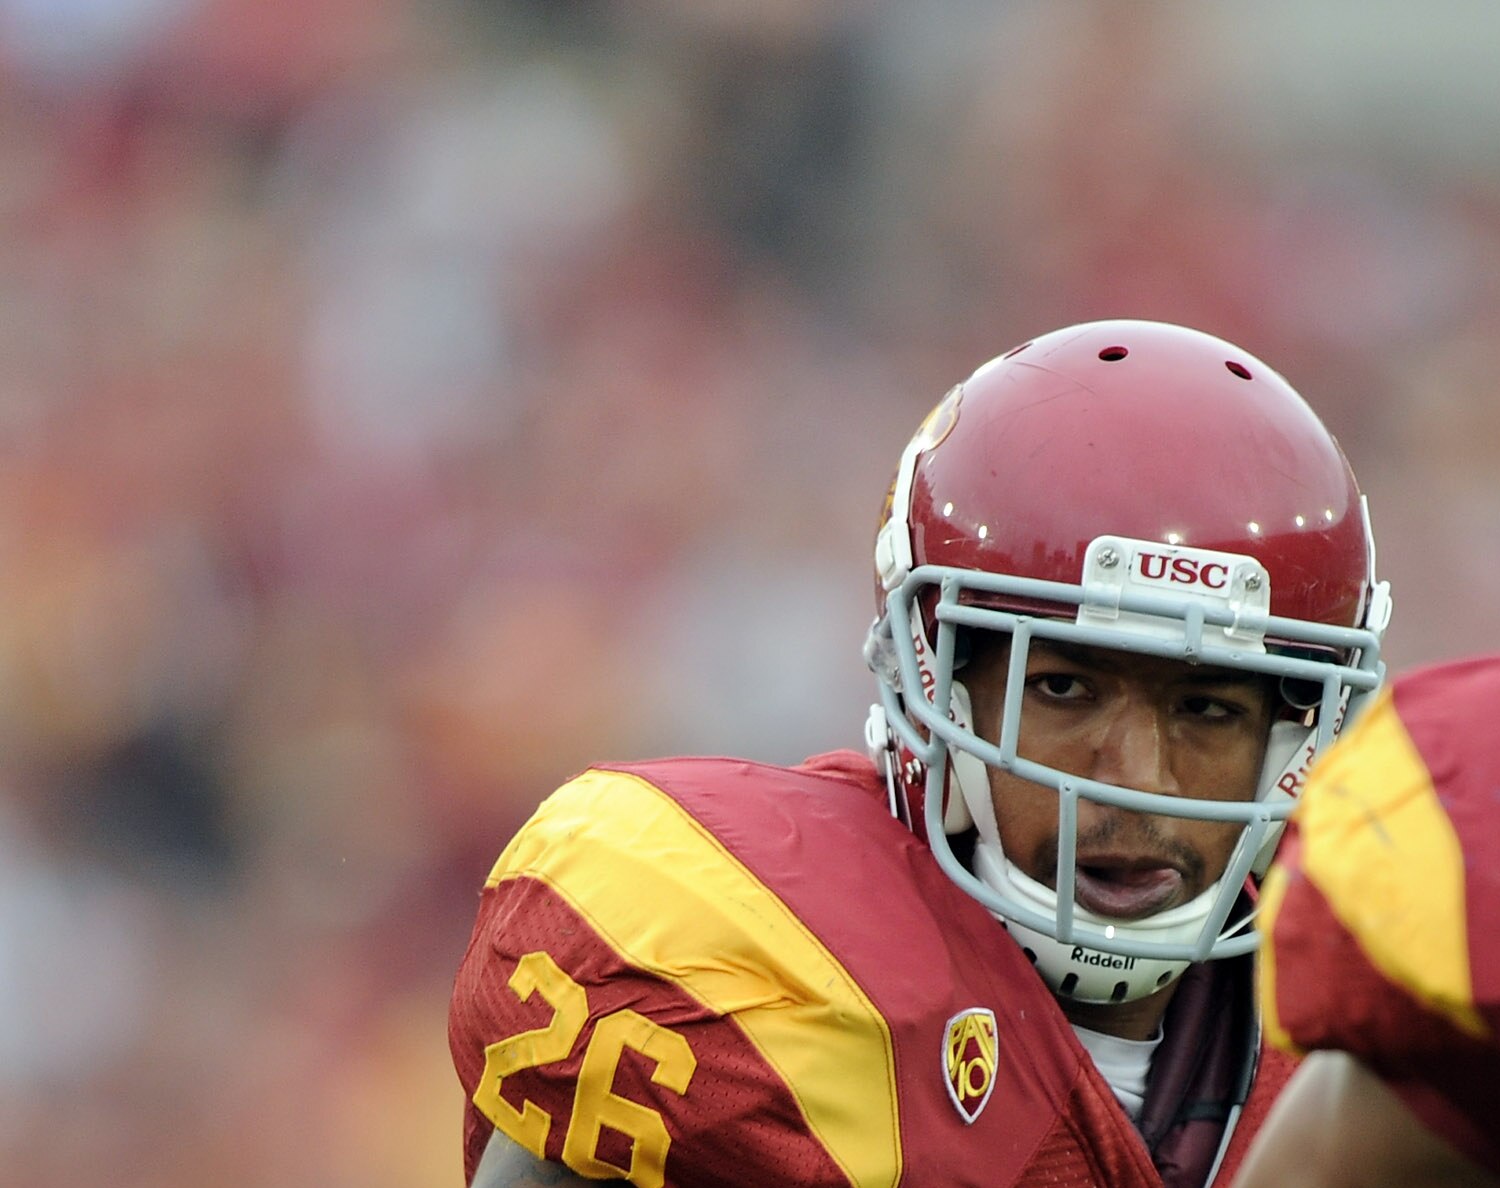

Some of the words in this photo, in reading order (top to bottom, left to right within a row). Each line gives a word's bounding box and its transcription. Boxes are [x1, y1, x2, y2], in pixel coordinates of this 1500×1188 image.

[1138, 553, 1229, 588] USC
[1071, 946, 1137, 970] Riddell
[958, 1057, 990, 1101] 10
